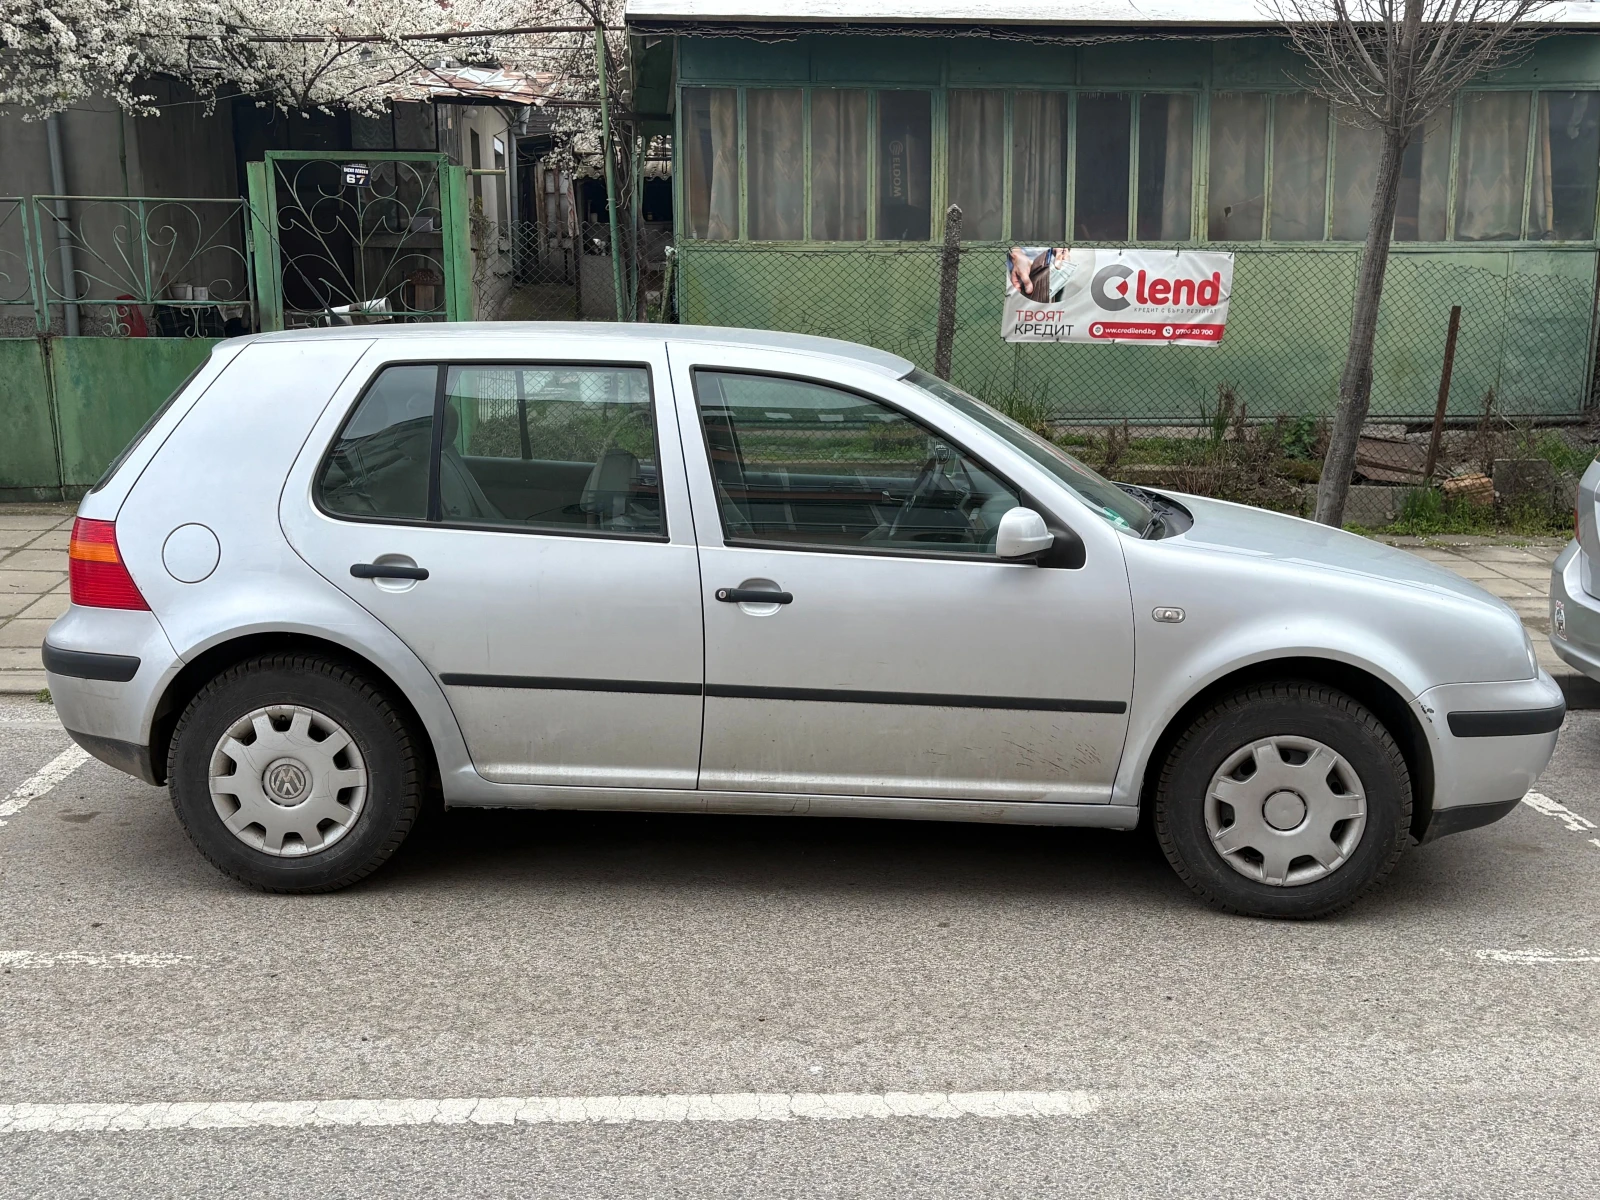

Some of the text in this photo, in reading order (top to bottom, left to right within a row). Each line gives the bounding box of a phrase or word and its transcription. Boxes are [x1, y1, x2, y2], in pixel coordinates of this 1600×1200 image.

[346, 174, 366, 184] 67
[893, 157, 901, 197] ELDOM
[1015, 310, 1064, 322] ТВОЯТ
[1014, 323, 1074, 337] КРЕДИТ
